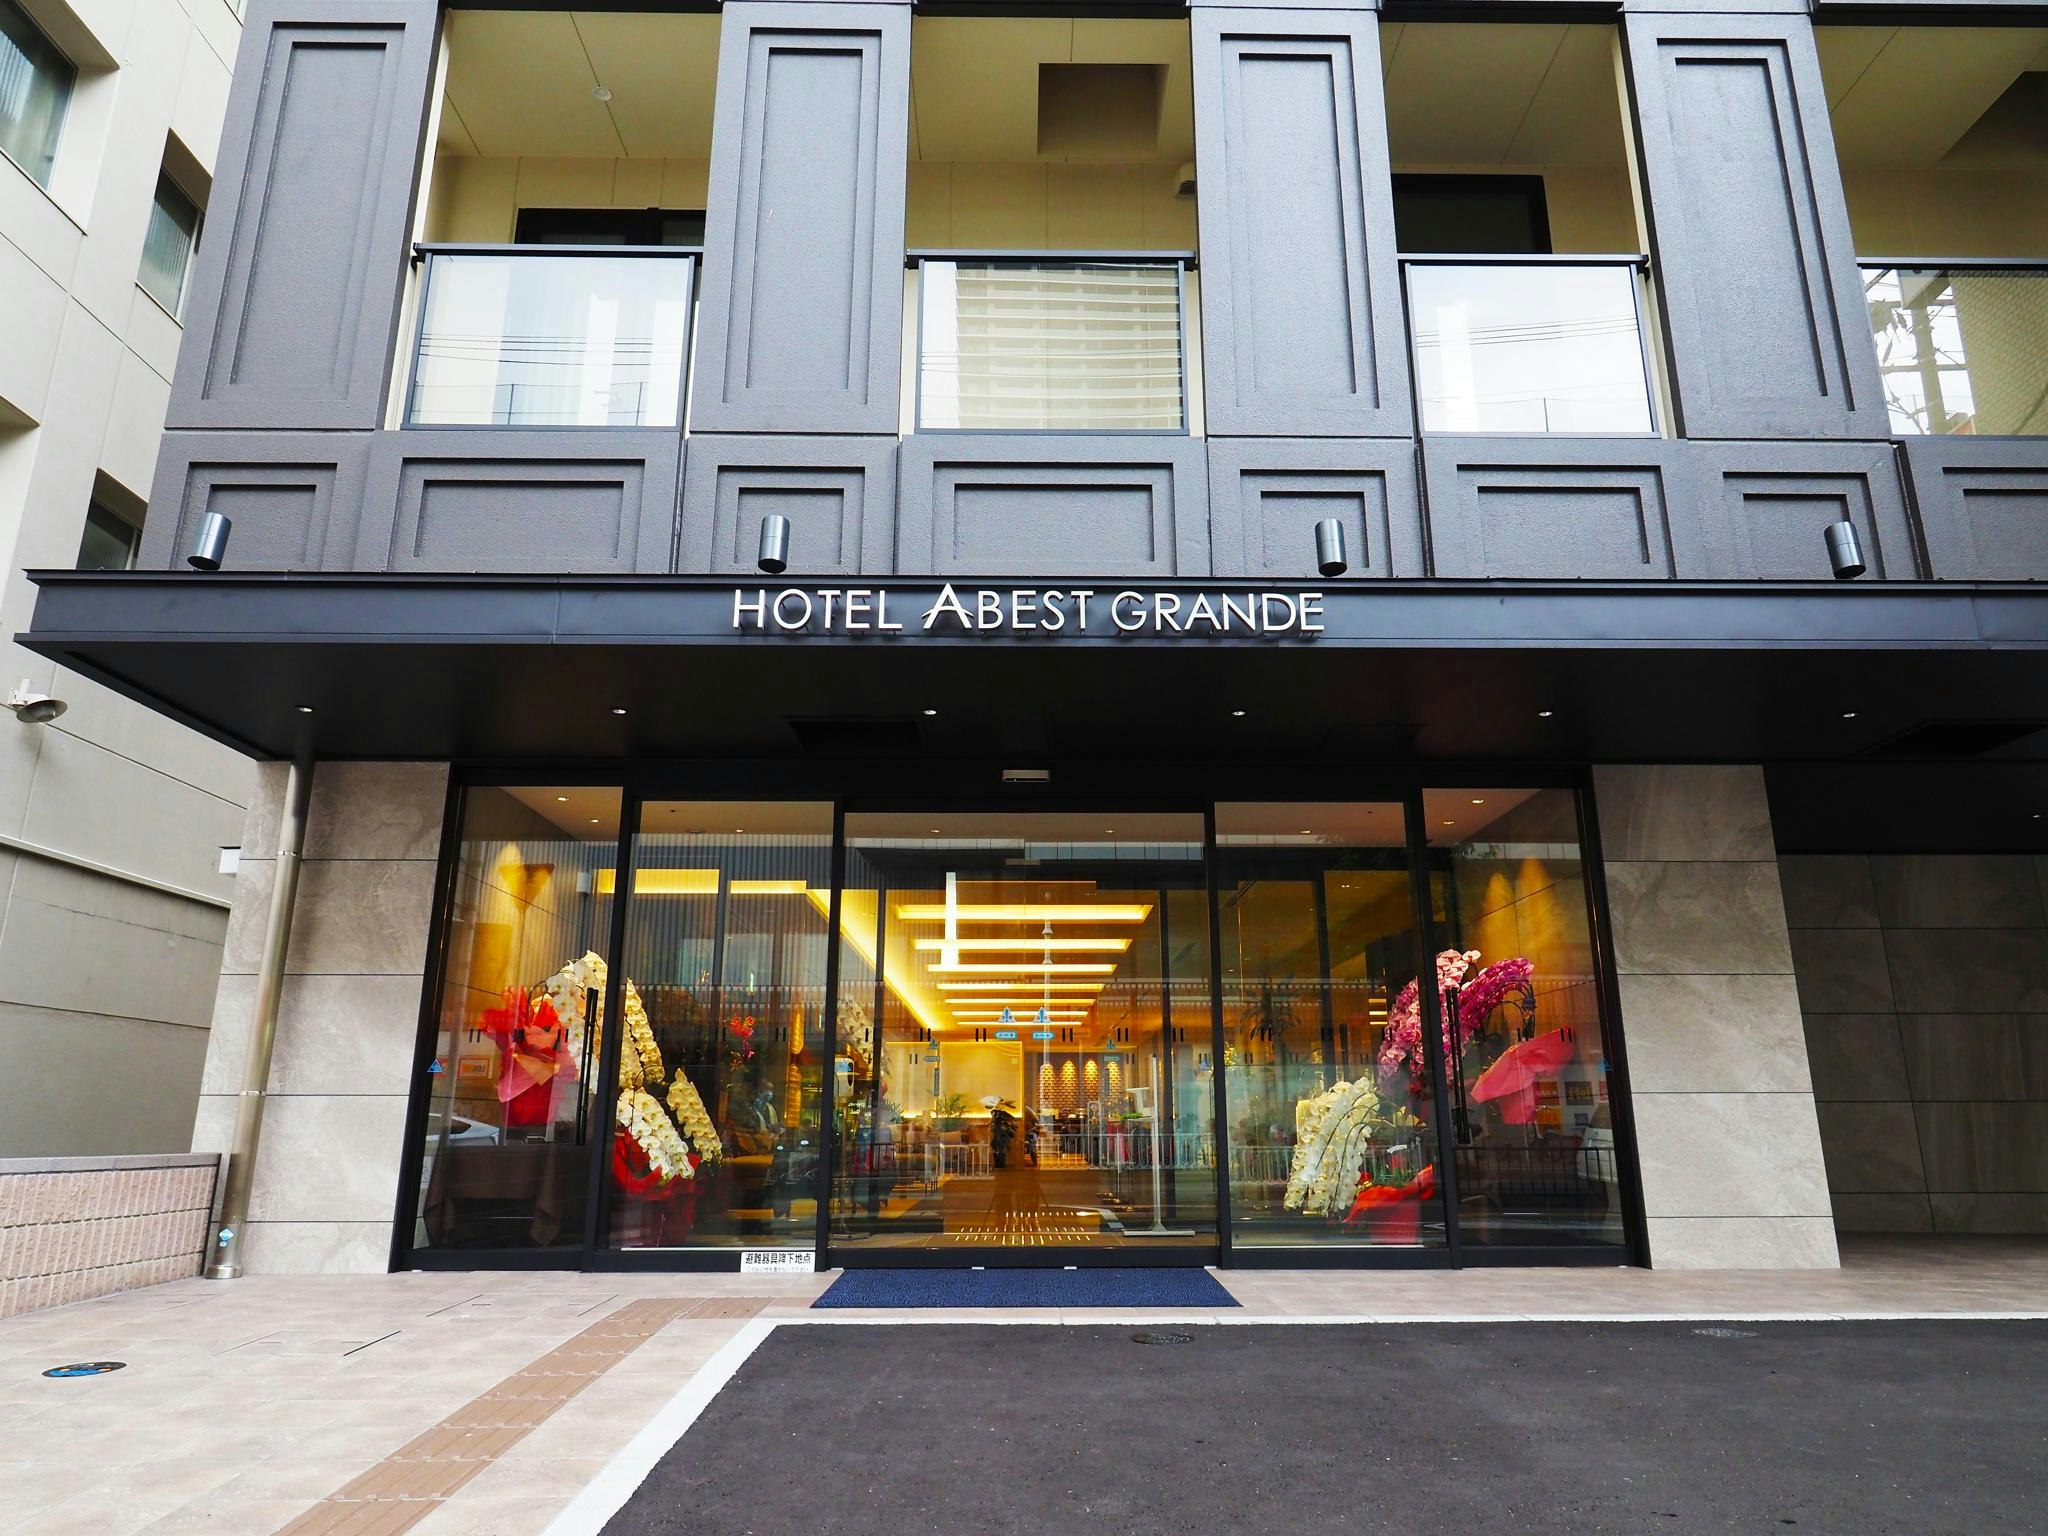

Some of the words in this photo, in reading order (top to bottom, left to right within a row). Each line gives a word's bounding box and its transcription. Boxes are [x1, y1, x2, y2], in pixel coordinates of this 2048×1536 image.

[732, 588, 903, 630] HOTEL
[921, 582, 1094, 630] ABEST
[1111, 590, 1325, 631] GRANDE
